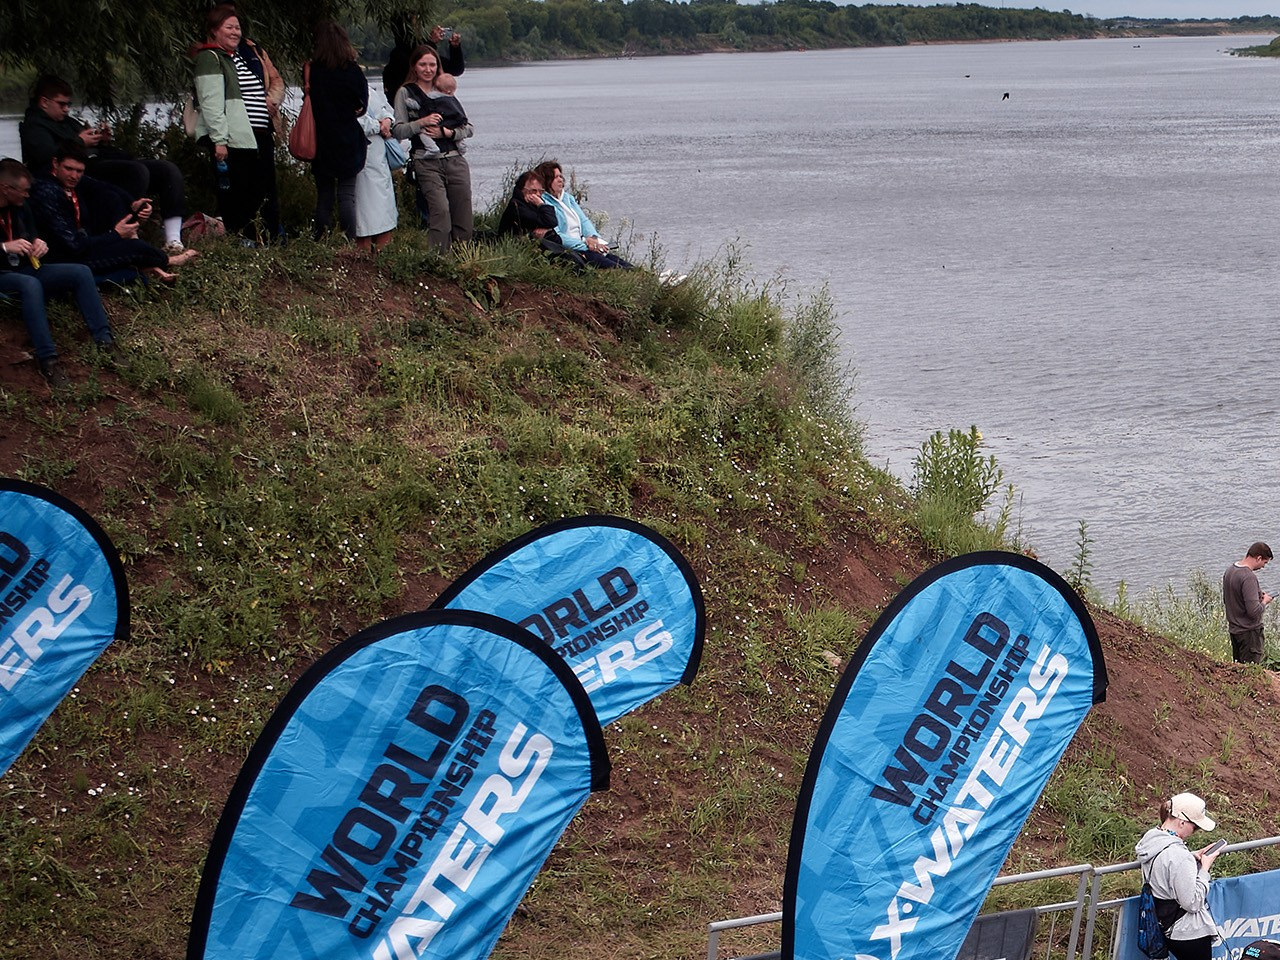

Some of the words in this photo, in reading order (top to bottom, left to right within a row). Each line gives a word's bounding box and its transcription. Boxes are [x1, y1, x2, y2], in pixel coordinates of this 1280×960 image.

[289, 684, 470, 920] WORLD
[869, 611, 1011, 807] WORLD
[912, 633, 1030, 826] CHAMPIONSHIP
[347, 708, 498, 940] CHAMPIONSHIP
